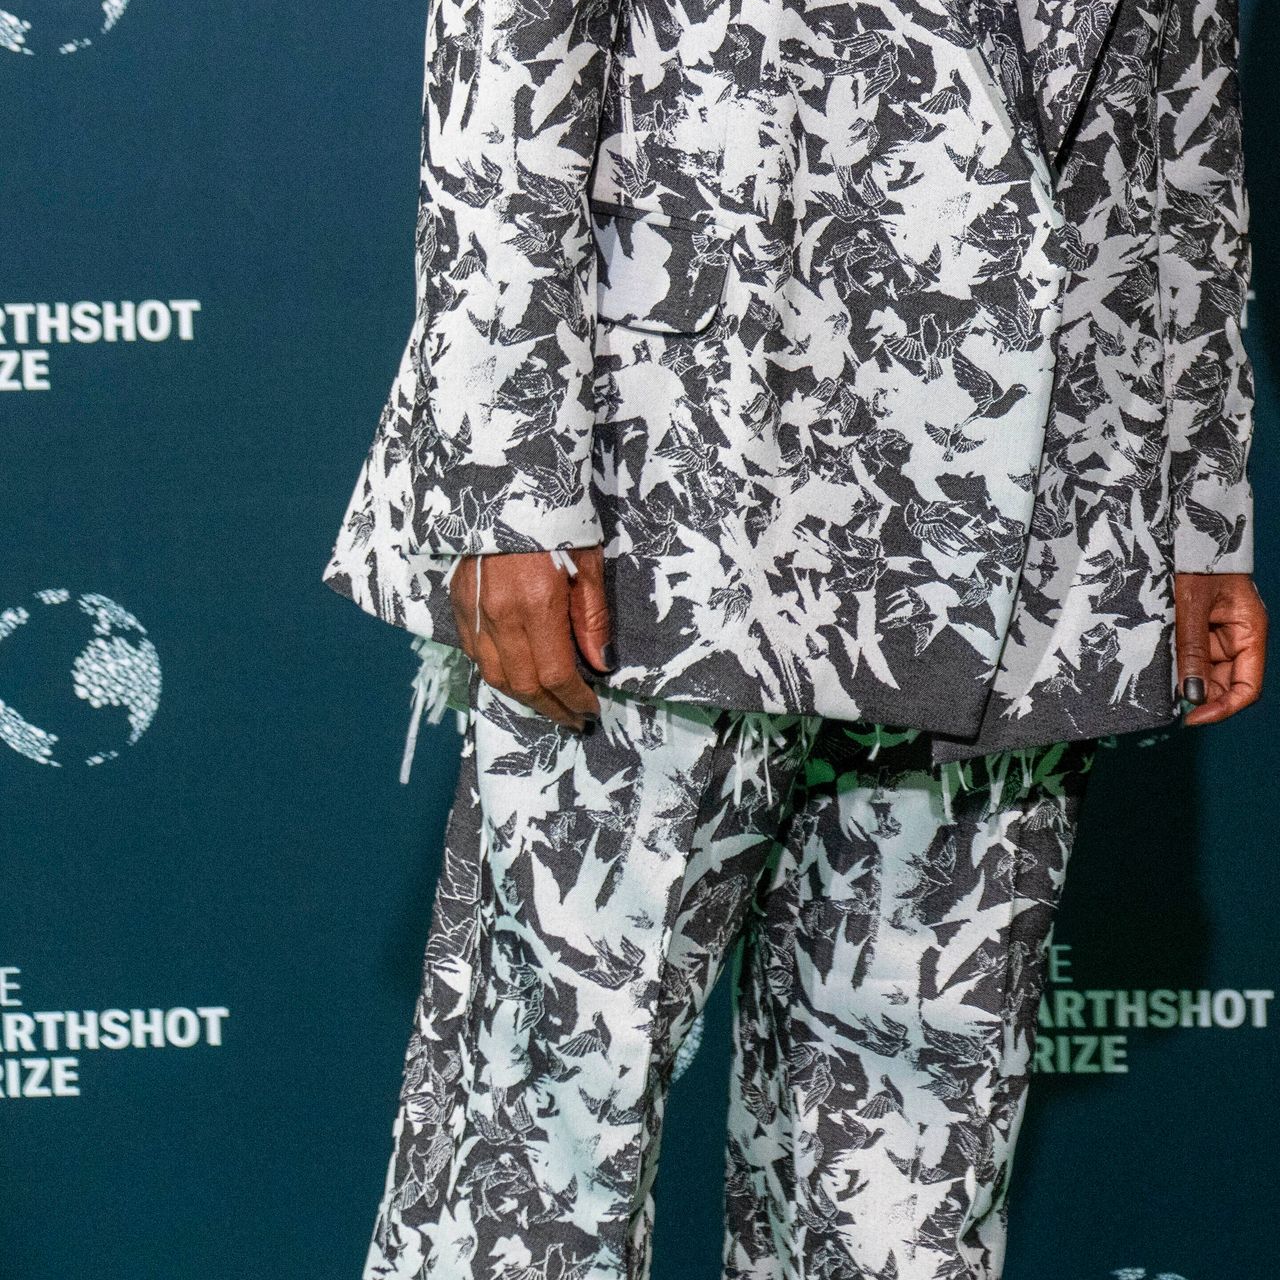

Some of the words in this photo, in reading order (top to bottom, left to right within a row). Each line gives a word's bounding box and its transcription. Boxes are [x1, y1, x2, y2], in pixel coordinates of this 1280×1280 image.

[0, 299, 201, 345] THSHOT
[0, 1006, 230, 1052] RTHSHOT
[0, 1057, 80, 1099] IZE
